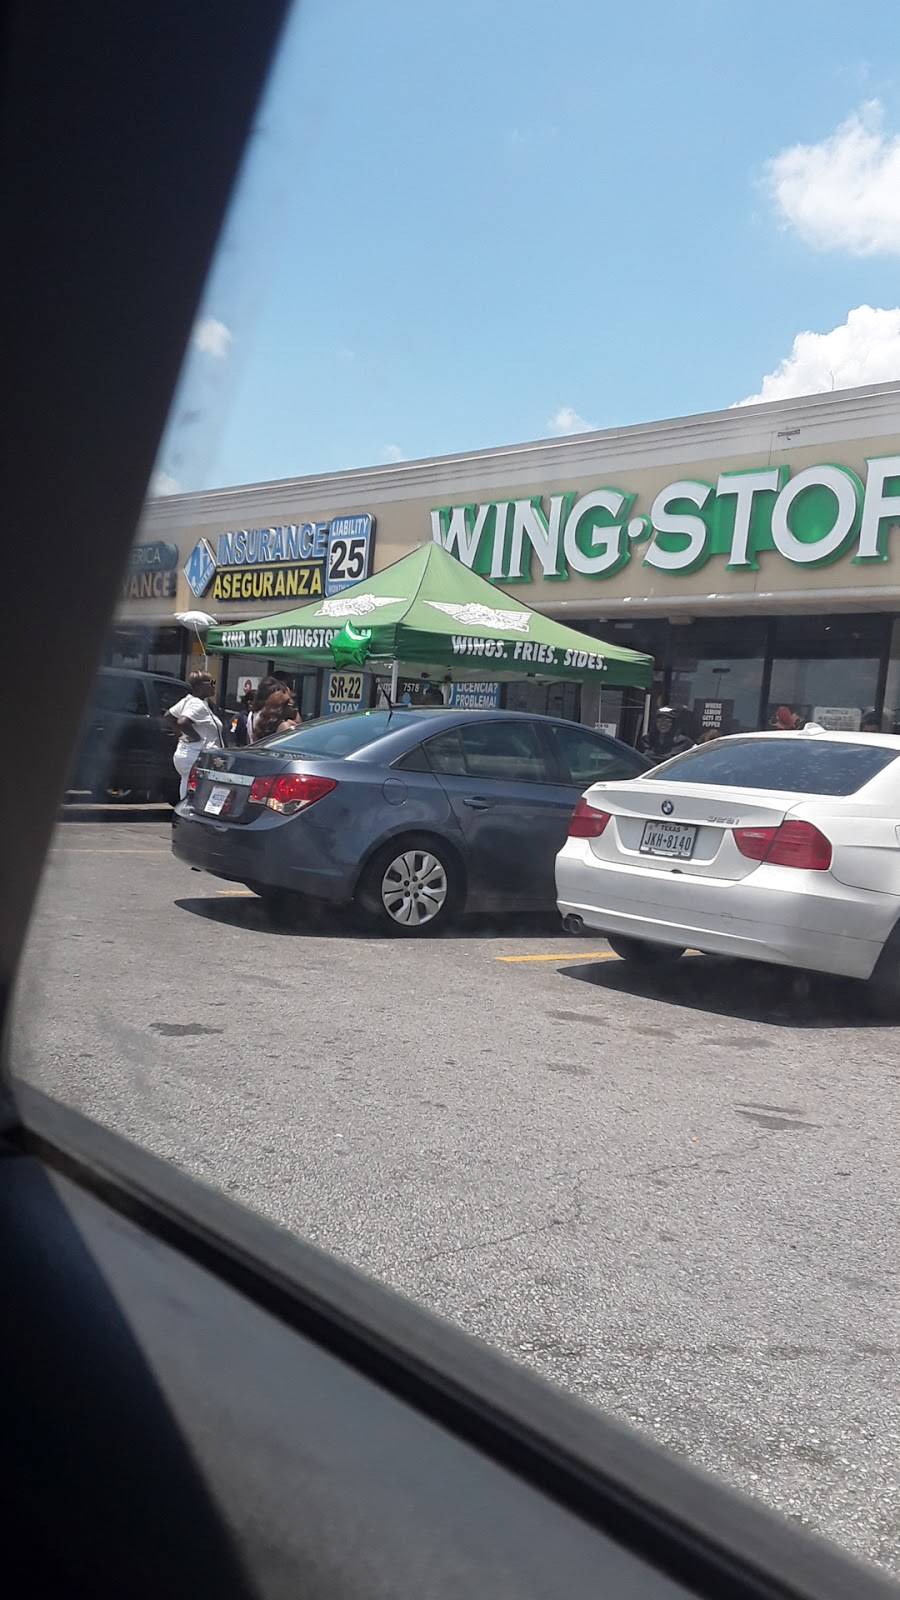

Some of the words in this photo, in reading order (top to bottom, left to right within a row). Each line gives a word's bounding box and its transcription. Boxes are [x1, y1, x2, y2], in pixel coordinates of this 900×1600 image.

[332, 517, 368, 536] LIABILITY
[216, 522, 327, 565] INSURANCE
[213, 567, 322, 599] ASEGURANZA
[222, 631, 246, 648] FIND
[249, 631, 263, 647] US
[265, 631, 279, 647] AT
[451, 636, 508, 659] WINGS.
[513, 641, 558, 665] FRIES.
[563, 648, 608, 671] SIDES.
[330, 676, 361, 699] SR-22
[456, 682, 499, 694] LICENCIA?
[328, 703, 360, 713] TODAY
[455, 694, 498, 708] PROBLEMA!
